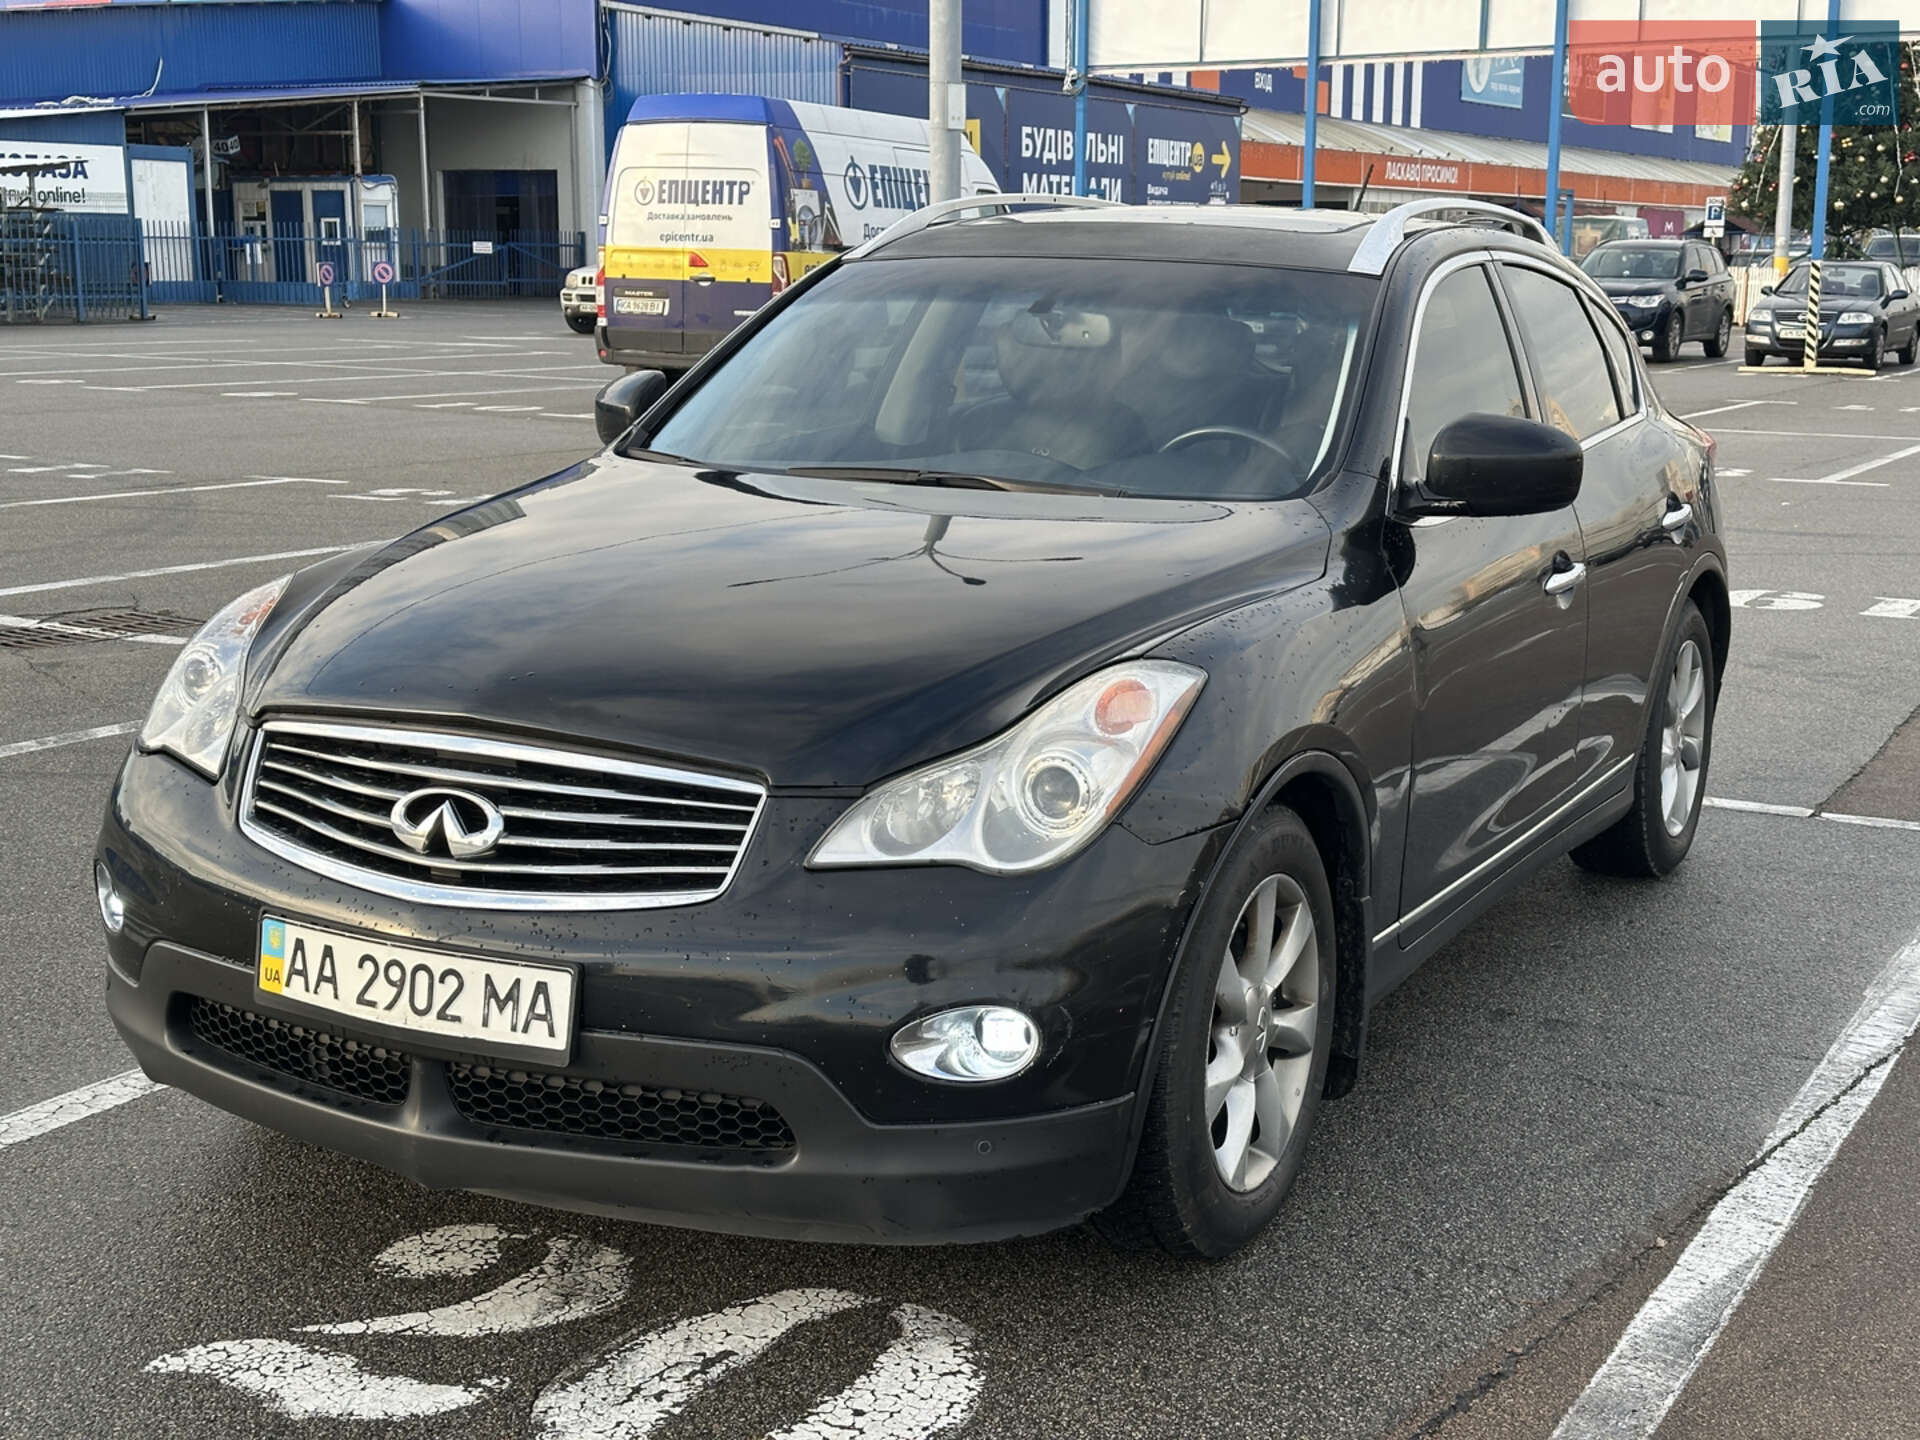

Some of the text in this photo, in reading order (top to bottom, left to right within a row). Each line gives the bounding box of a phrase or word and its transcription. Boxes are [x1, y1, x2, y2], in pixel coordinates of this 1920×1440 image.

[1254, 72, 1273, 93] ВХІД
[1021, 126, 1124, 165] БУДІВЛЬНІ
[657, 179, 751, 207] ЕПІЦЕНТР
[647, 211, 685, 221] Доставка
[659, 231, 714, 243] epicentr.ua
[264, 968, 281, 985] UA
[285, 937, 556, 1038] AA 2902 MA
